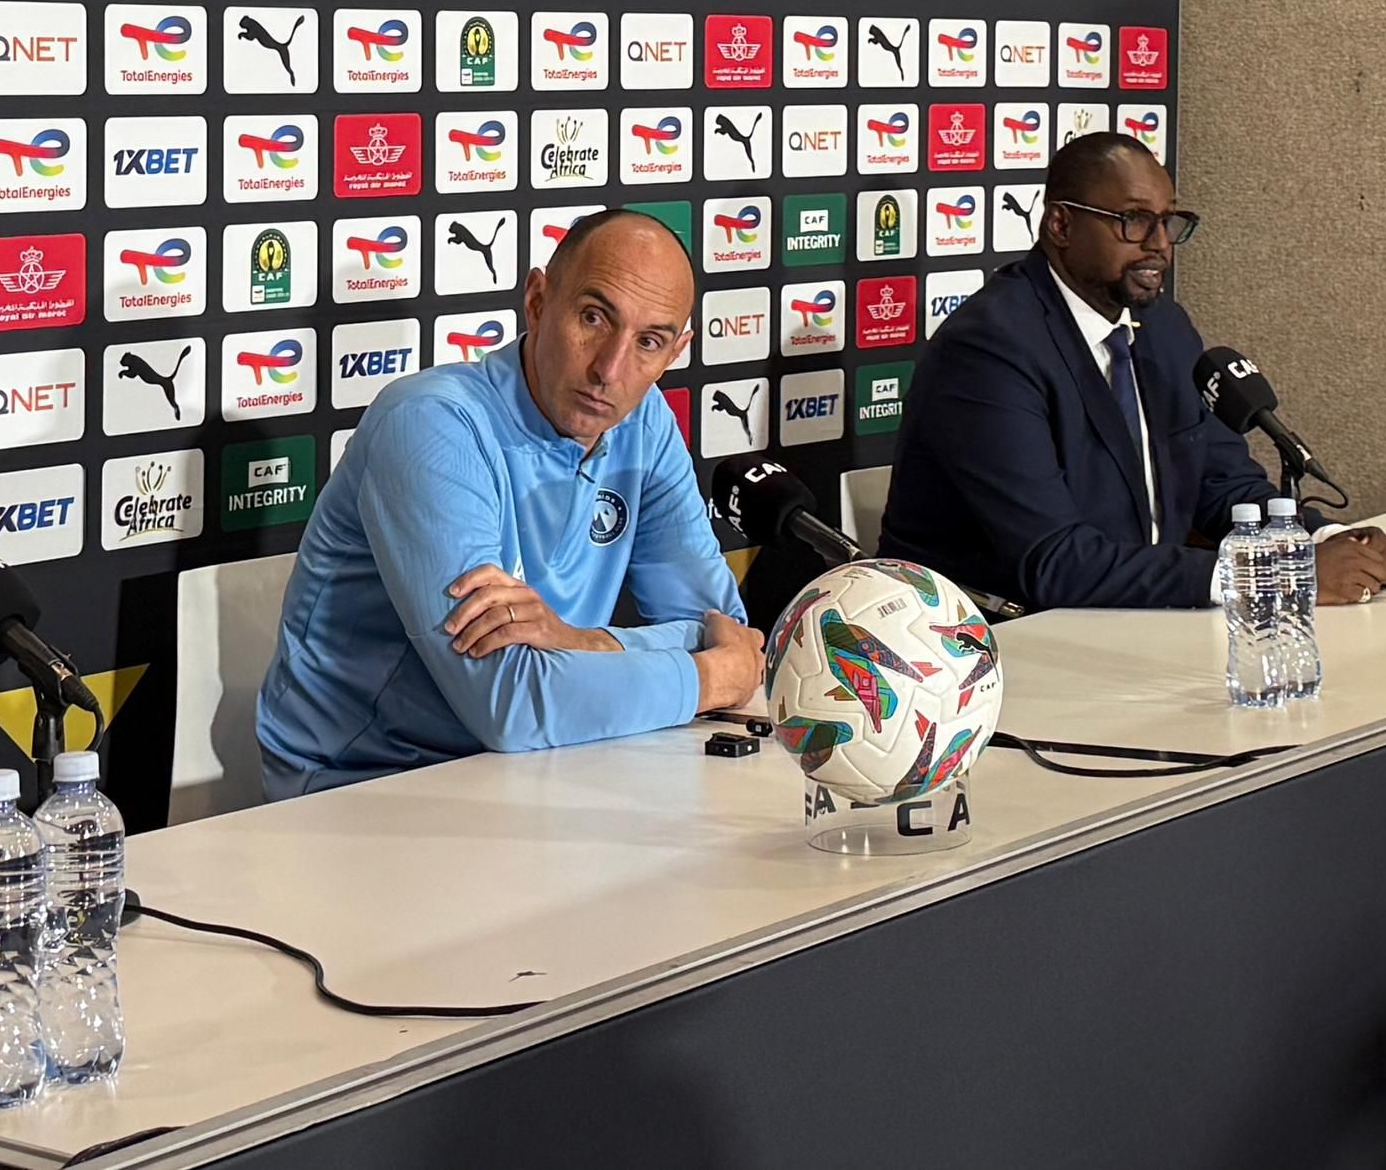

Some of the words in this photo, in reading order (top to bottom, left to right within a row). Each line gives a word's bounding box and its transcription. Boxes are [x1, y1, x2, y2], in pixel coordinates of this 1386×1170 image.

[628, 41, 687, 62] QNET
[1000, 45, 1045, 63] QNET
[121, 70, 192, 84] TotalEnergies
[347, 70, 409, 83] TotalEnergies
[543, 69, 597, 81] TotalEnergies
[789, 131, 841, 151] QNET
[114, 148, 198, 175] 1XBET
[541, 144, 598, 170] Celebrate
[448, 170, 506, 182] TotalEnergies
[551, 162, 586, 177] Africa
[238, 178, 304, 191] TotalEnergies
[805, 216, 825, 224] CAF
[788, 234, 840, 250] INTEGRITY
[346, 276, 408, 290] TotalEnergies
[120, 294, 191, 308] TotalEnergies
[931, 295, 968, 317] 1XB
[709, 314, 764, 338] QNET
[340, 348, 412, 379] 1XBET
[237, 390, 303, 410] TotalEnergies
[1202, 372, 1220, 412] AF
[786, 394, 838, 421] 1XBET
[860, 402, 902, 419] INTEGRIT
[254, 463, 287, 479] CAF
[230, 485, 306, 512] INTEGRITY
[114, 494, 191, 524] Celebrate
[729, 494, 749, 538] AF
[125, 513, 174, 532] Africa
